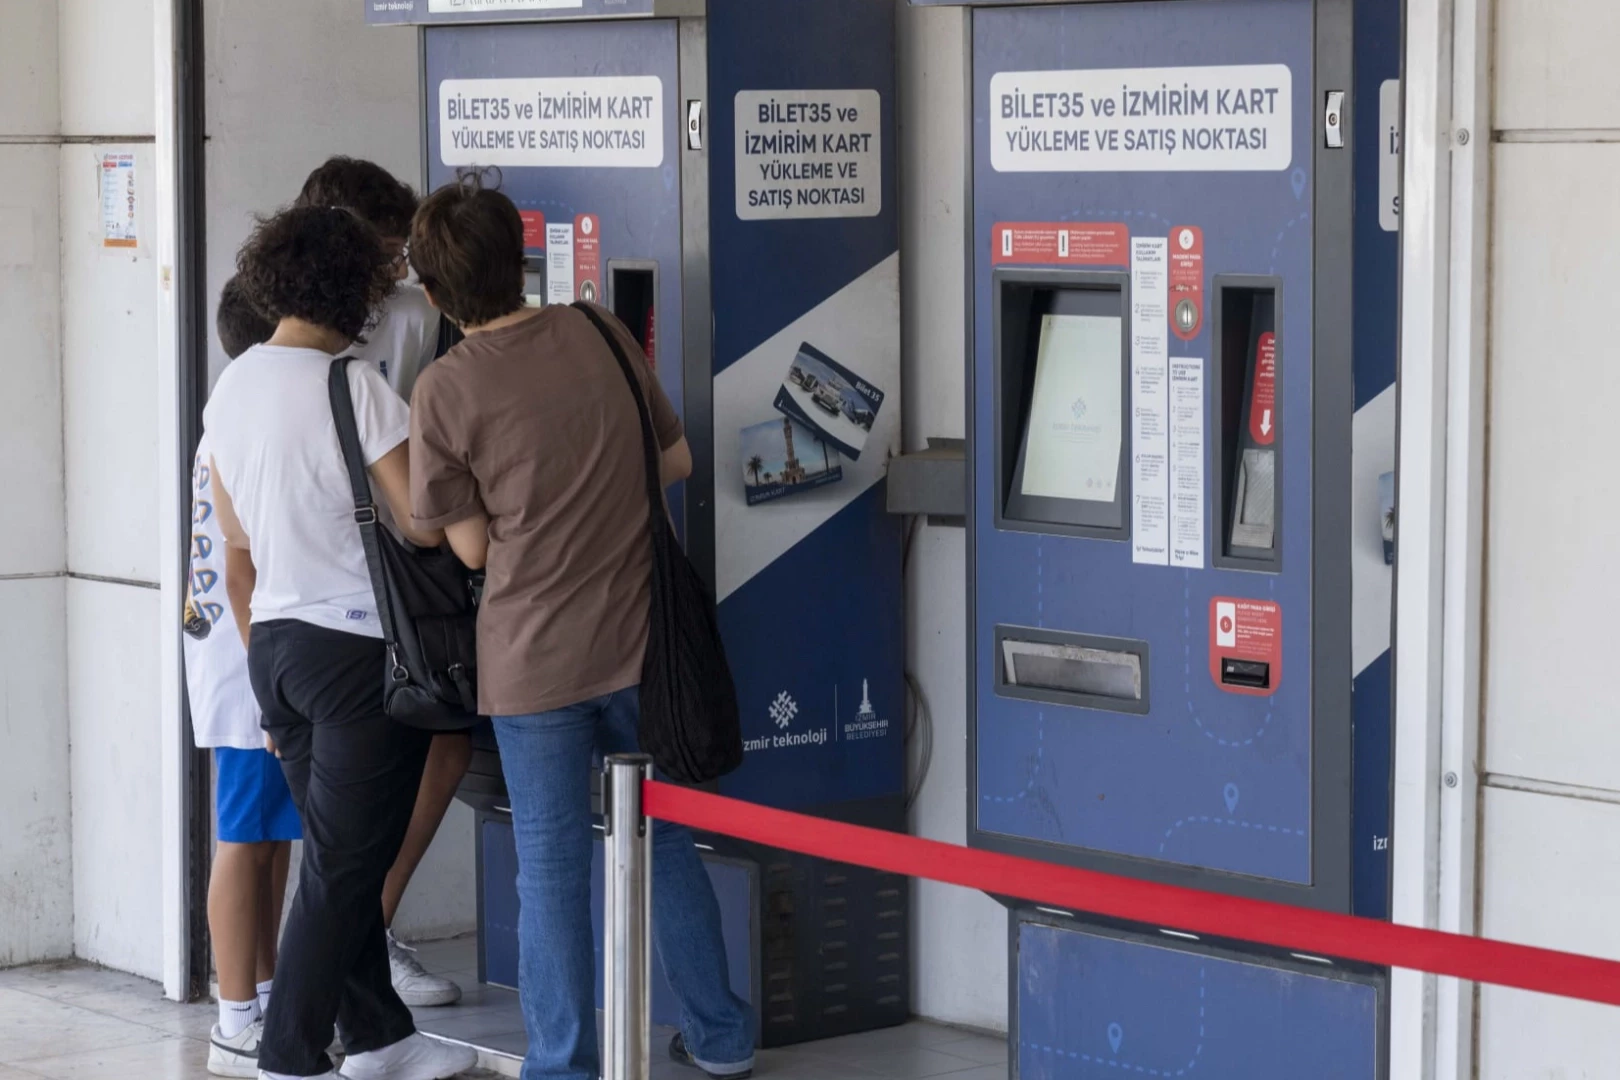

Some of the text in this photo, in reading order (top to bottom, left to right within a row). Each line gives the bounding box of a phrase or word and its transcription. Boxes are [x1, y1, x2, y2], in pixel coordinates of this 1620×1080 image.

[447, 91, 653, 119] BİLET35 ve İZMİRİM KART
[758, 98, 858, 123] BİLET35 ve
[1001, 83, 1278, 119] BİLET35 ve İZMİRİM KART
[452, 126, 645, 153] YÜKLEME VE SATIŞ NOKTASI
[745, 129, 871, 154] İZMİRİM KART
[1006, 126, 1266, 155] YÜKLEME VE SATIŞ NOKTASI
[760, 160, 857, 180] YÜKLEME VE
[749, 188, 864, 209] SATIŞ NOKTASI
[773, 728, 827, 748] teknoloji
